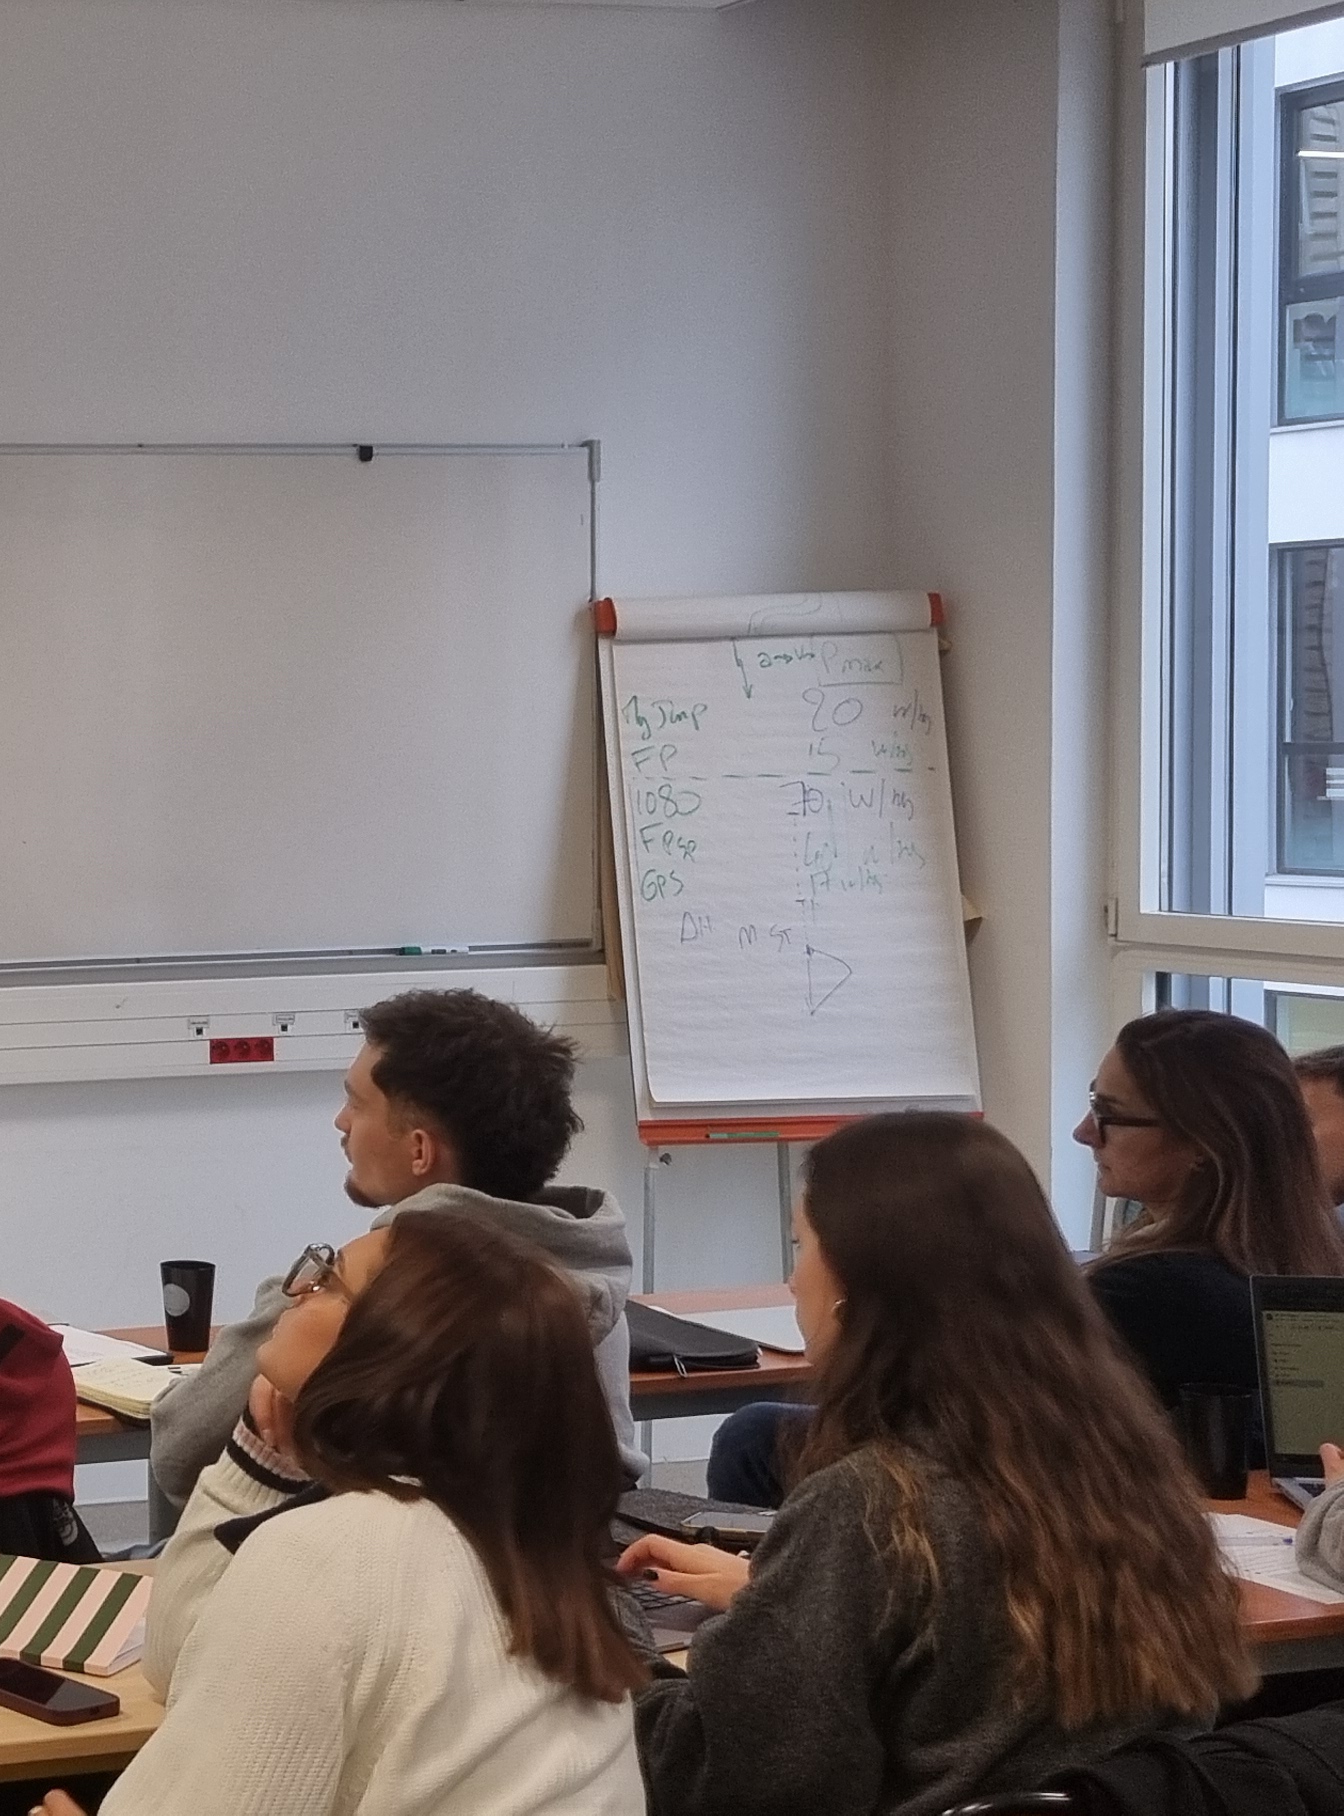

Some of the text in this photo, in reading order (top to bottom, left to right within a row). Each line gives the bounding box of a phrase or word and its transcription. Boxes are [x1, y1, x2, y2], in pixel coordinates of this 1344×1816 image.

[630, 743, 678, 774] FP
[637, 783, 703, 819] 1080
[640, 868, 685, 902] GPS
